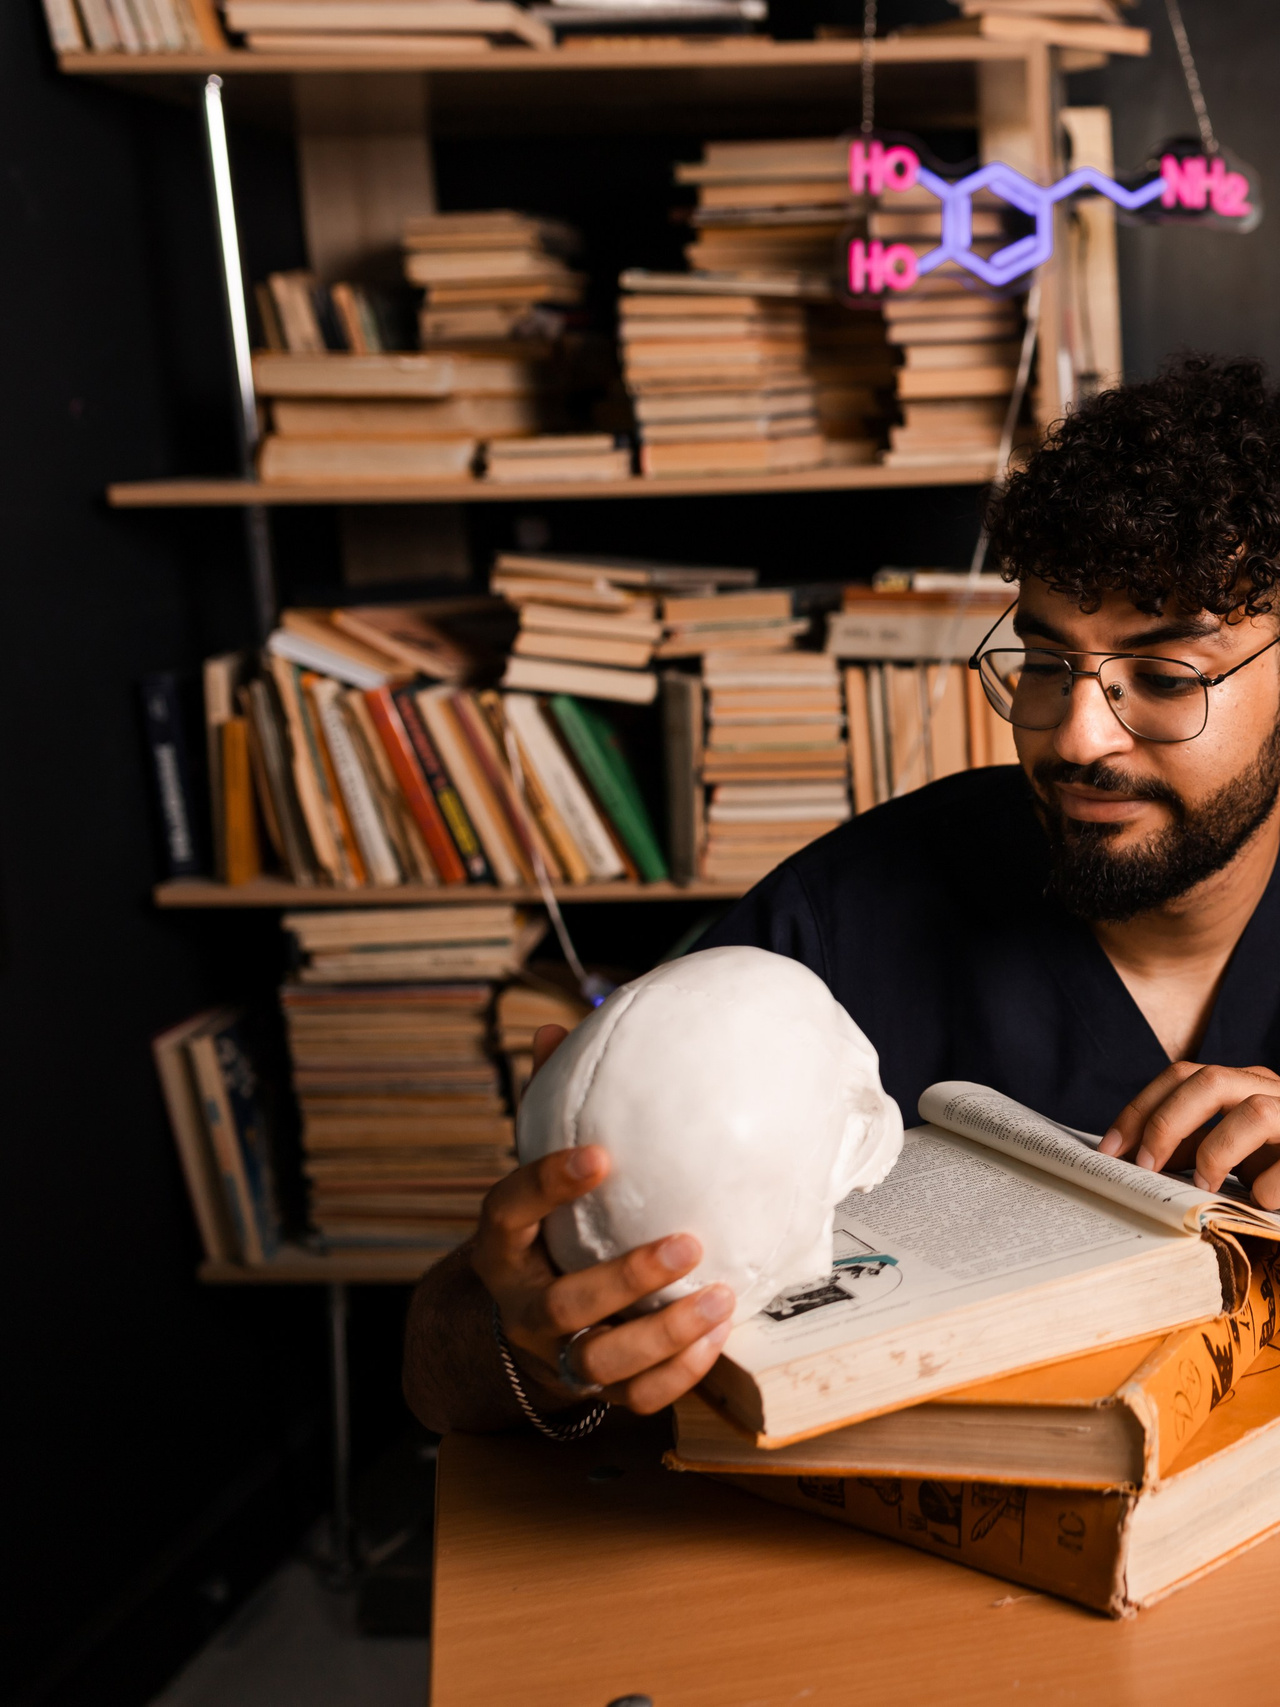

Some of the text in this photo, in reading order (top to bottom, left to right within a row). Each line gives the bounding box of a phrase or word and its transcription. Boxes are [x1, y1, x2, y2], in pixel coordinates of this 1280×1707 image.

[849, 140, 920, 195] HO
[1160, 154, 1253, 217] NH2
[849, 239, 920, 292] HO
